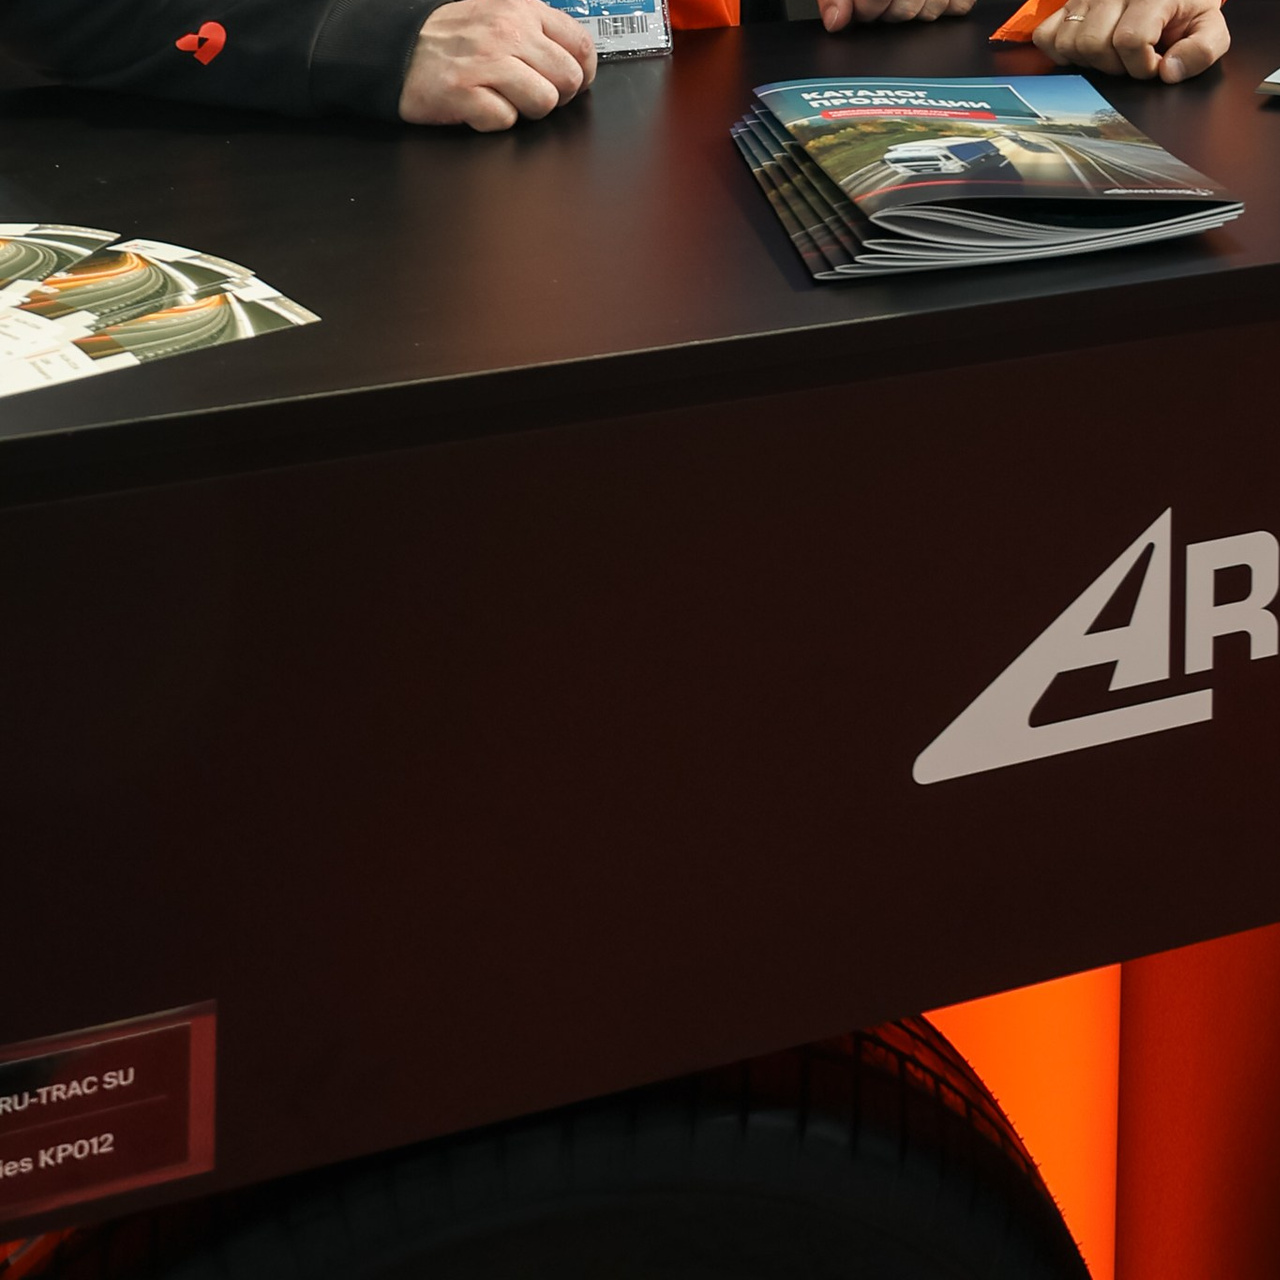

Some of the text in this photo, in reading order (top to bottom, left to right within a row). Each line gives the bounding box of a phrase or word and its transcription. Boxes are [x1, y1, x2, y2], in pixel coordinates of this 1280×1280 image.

[801, 89, 928, 101] КАТАЛОГ
[808, 97, 992, 110] ПРОДУКЦИИ
[103, 1067, 135, 1090] SU
